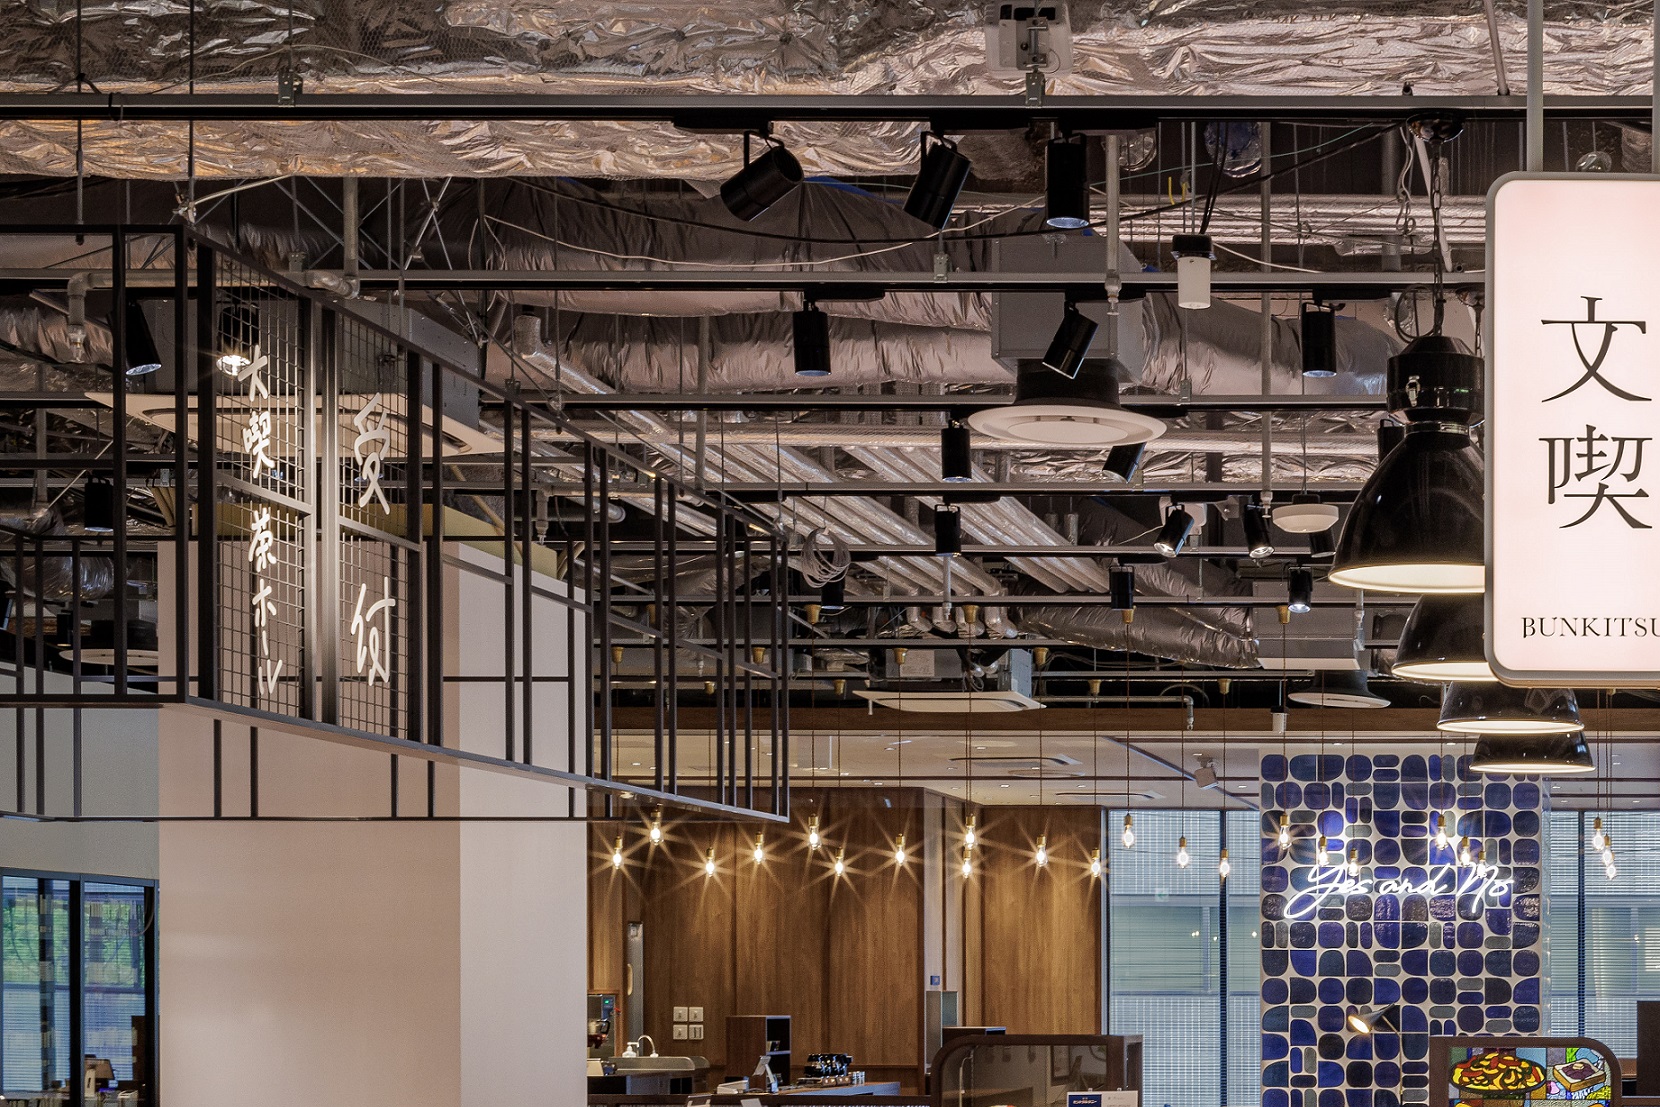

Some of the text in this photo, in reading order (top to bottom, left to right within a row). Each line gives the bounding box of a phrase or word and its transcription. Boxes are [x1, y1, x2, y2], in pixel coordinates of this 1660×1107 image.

[1538, 295, 1653, 530] 文喫
[350, 391, 396, 687] 受付
[1283, 862, 1515, 919] Yes and No
